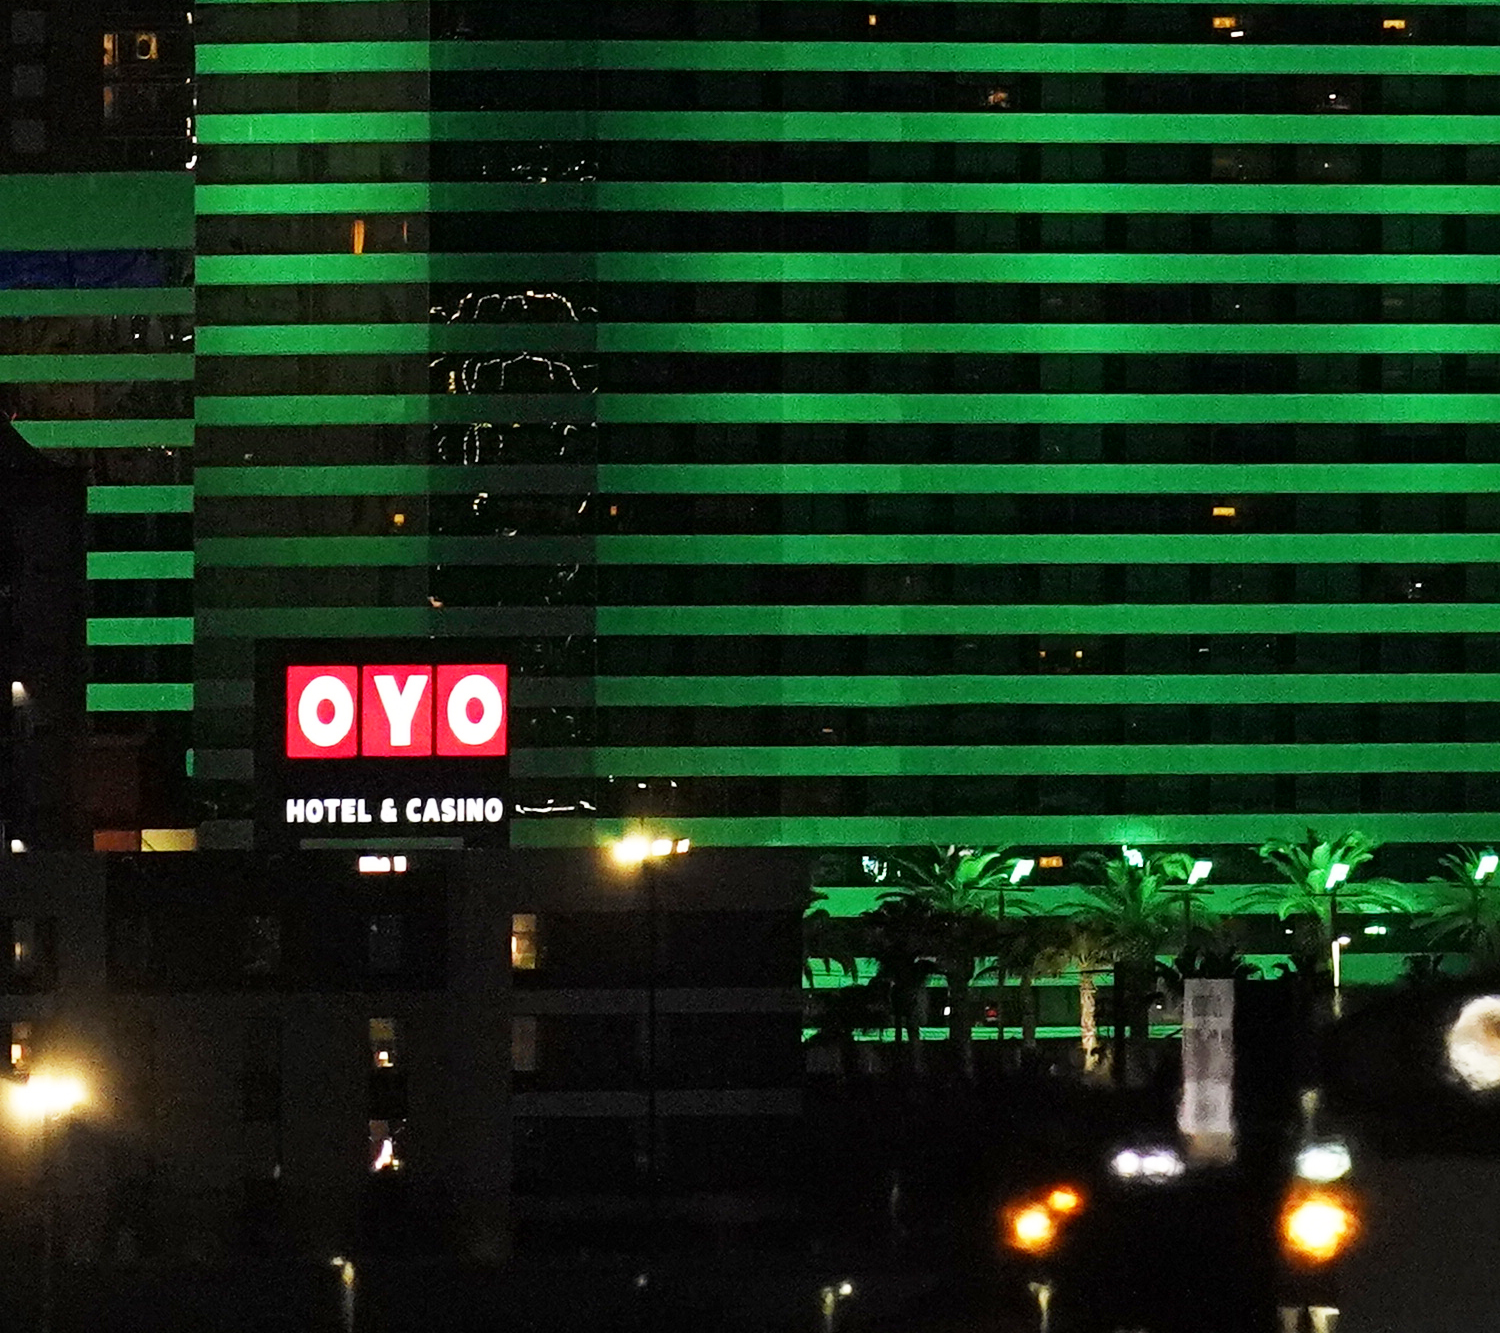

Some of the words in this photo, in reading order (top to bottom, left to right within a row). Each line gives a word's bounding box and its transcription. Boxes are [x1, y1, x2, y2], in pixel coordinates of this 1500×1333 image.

[298, 674, 504, 747] OYO
[286, 799, 372, 823] HOTEL
[380, 799, 398, 823] &
[406, 797, 503, 823] CASINO
